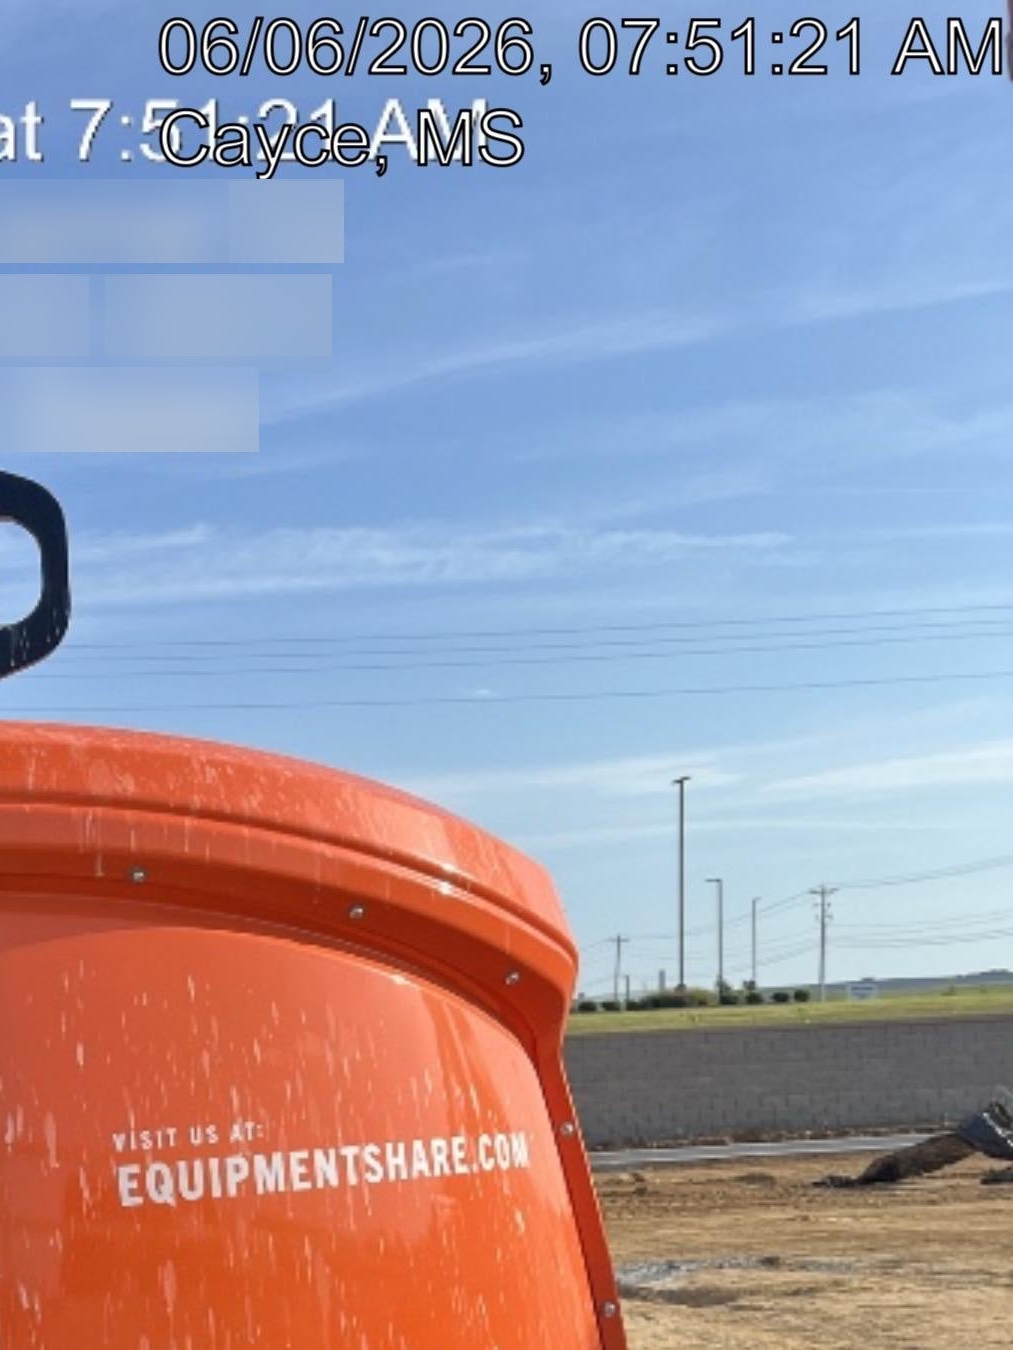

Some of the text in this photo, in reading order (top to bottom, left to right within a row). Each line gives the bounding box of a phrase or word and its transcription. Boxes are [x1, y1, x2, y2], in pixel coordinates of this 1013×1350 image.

[112, 1127, 177, 1152] VISIT
[190, 1124, 219, 1145] US
[117, 1131, 530, 1208] EQUIPMENTSHARE.COM
